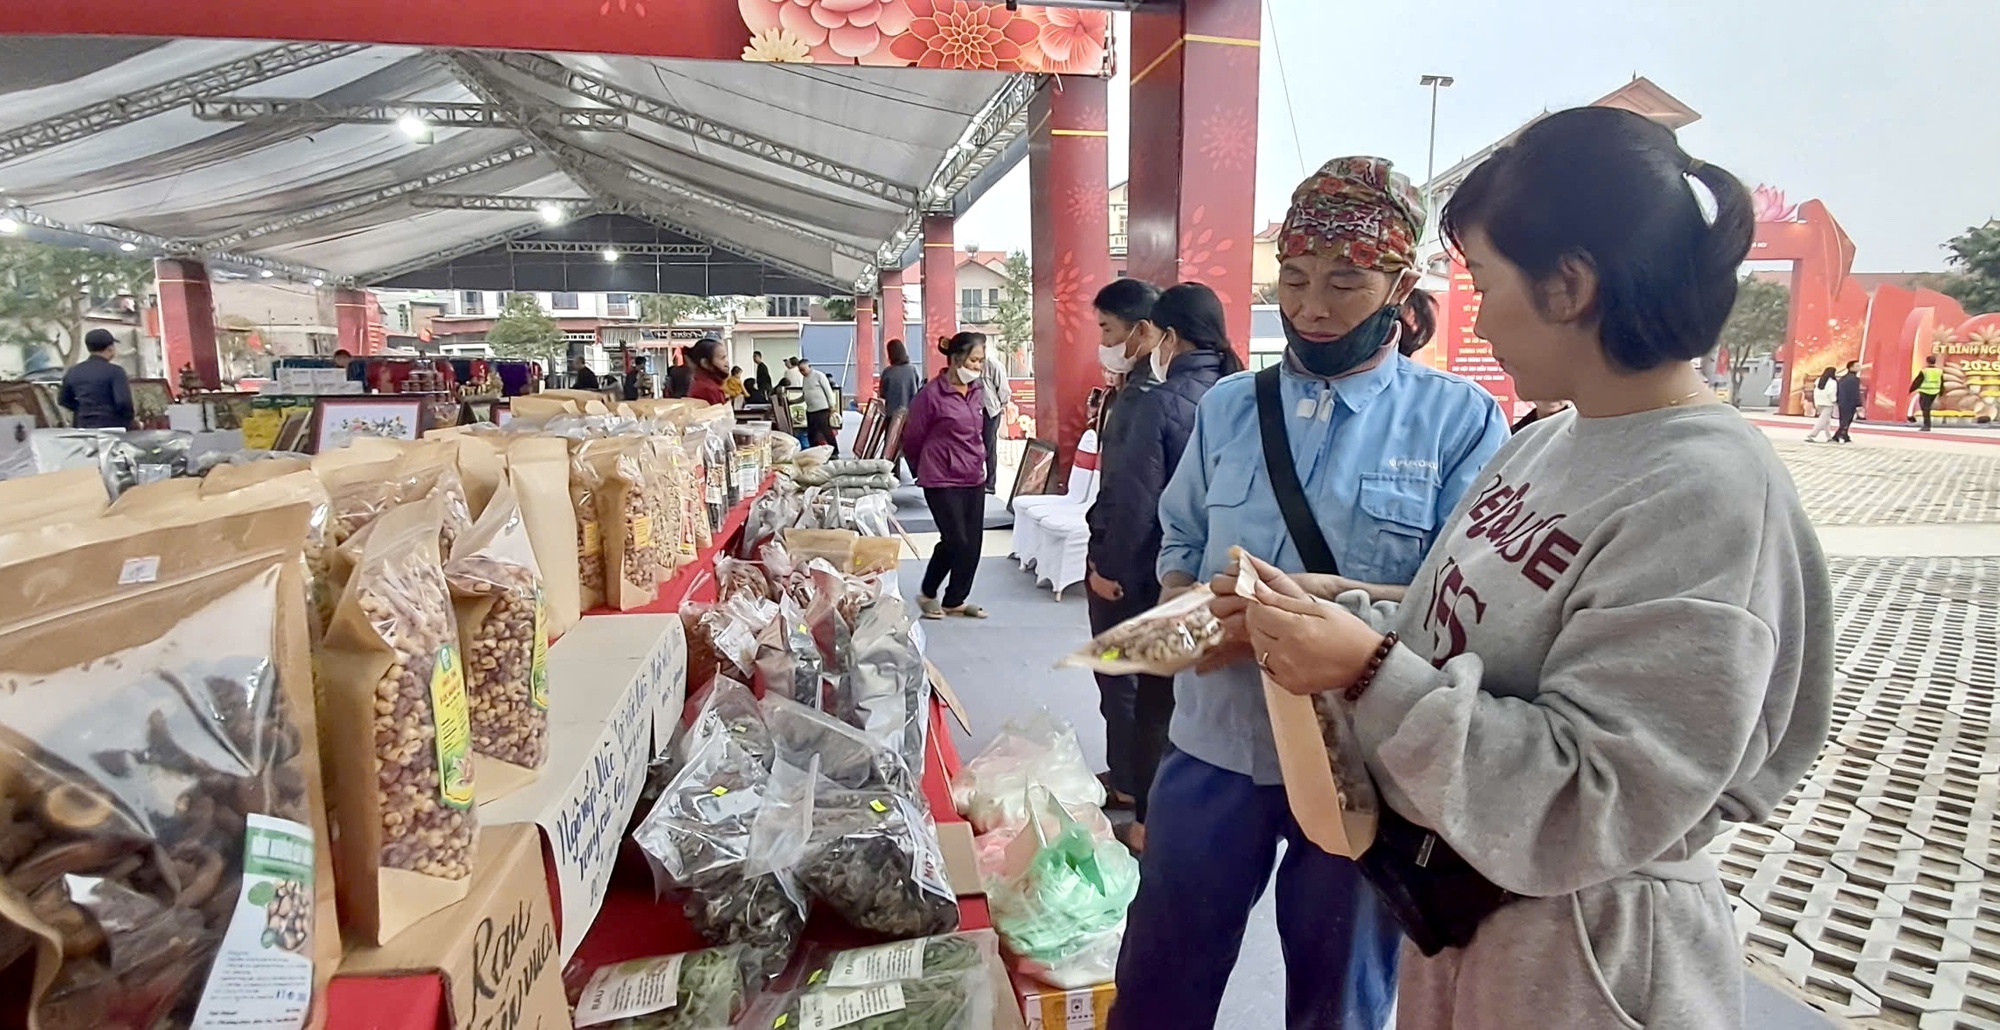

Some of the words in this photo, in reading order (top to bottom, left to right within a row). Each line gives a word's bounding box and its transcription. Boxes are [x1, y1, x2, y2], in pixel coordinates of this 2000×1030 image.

[1932, 341, 1947, 354] ẾT
[1948, 342, 1978, 355] BÍNH
[1960, 360, 2000, 371] 2026
